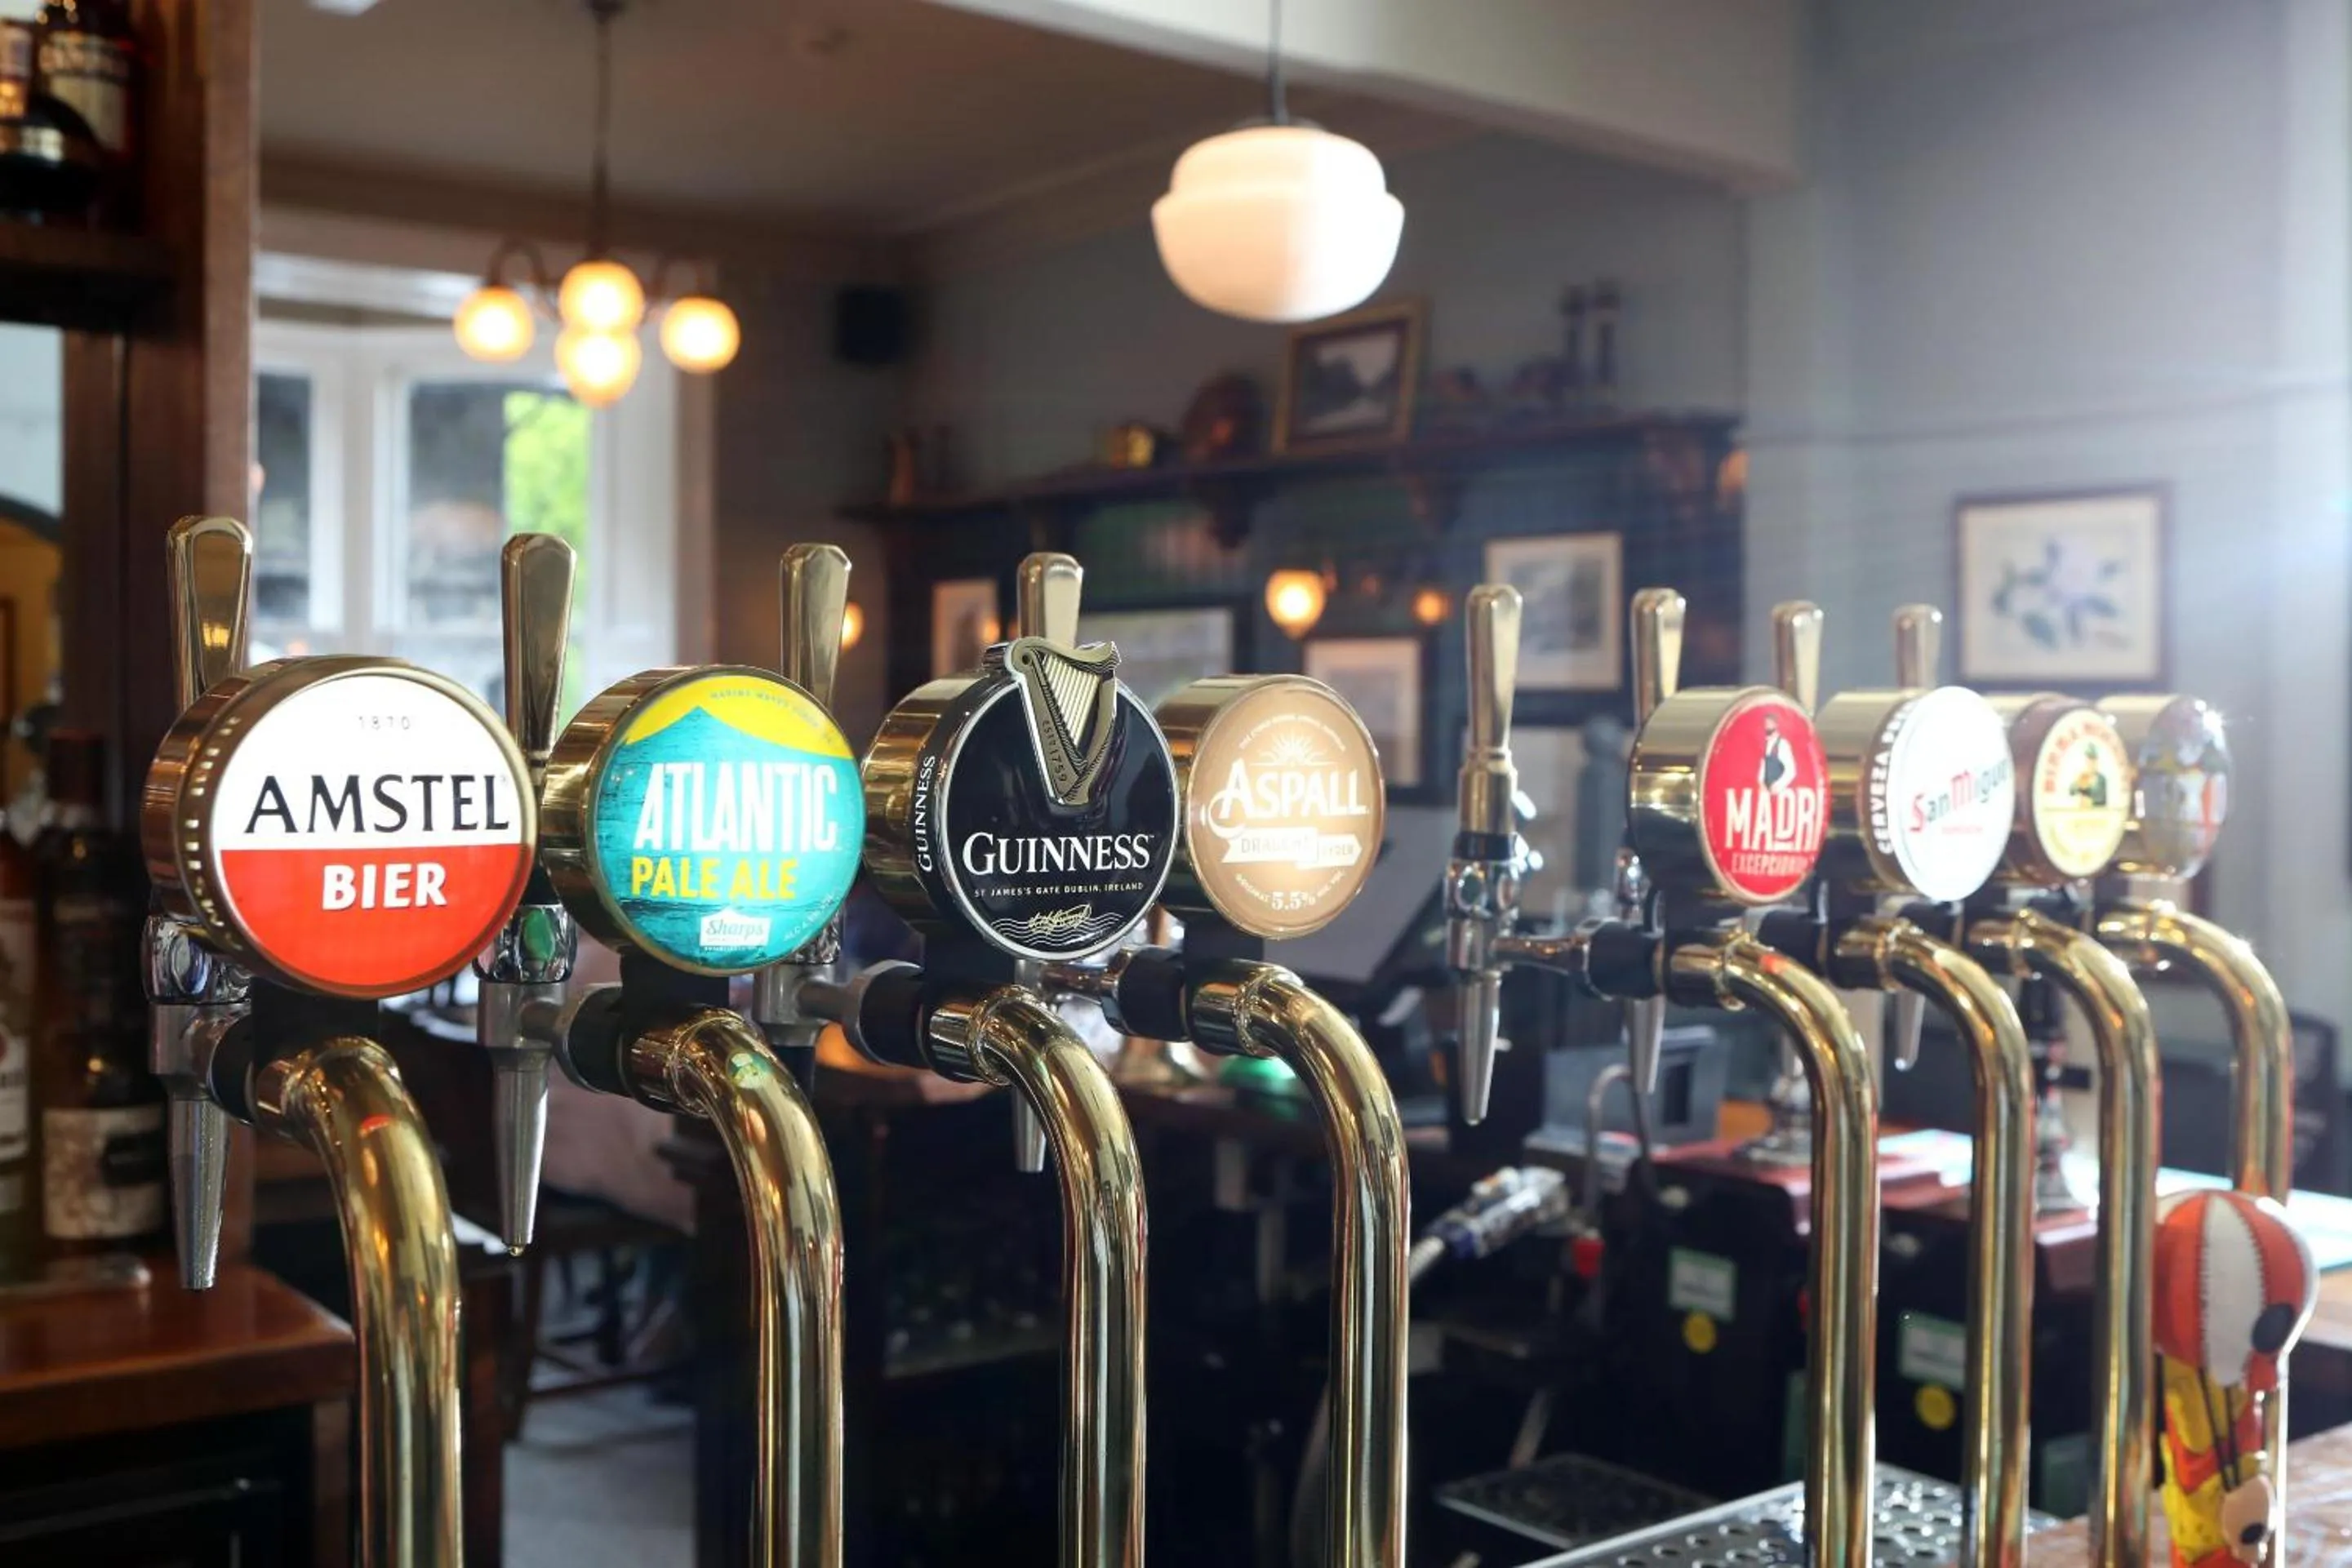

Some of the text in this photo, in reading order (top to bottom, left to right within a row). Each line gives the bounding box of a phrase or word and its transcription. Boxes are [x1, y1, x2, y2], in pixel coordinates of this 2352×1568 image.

[243, 774, 510, 834] AMSTEL
[633, 762, 838, 853] ATLANTIC
[914, 755, 936, 873] GUINNESS
[1208, 757, 1369, 838] ASPALL
[631, 856, 799, 900] PALE ALE
[962, 831, 1151, 876] GUINNESS
[322, 862, 448, 911] BIER
[990, 886, 1032, 897] JAMES'S
[1035, 885, 1061, 895] GATE
[1104, 882, 1145, 891] IRELAND
